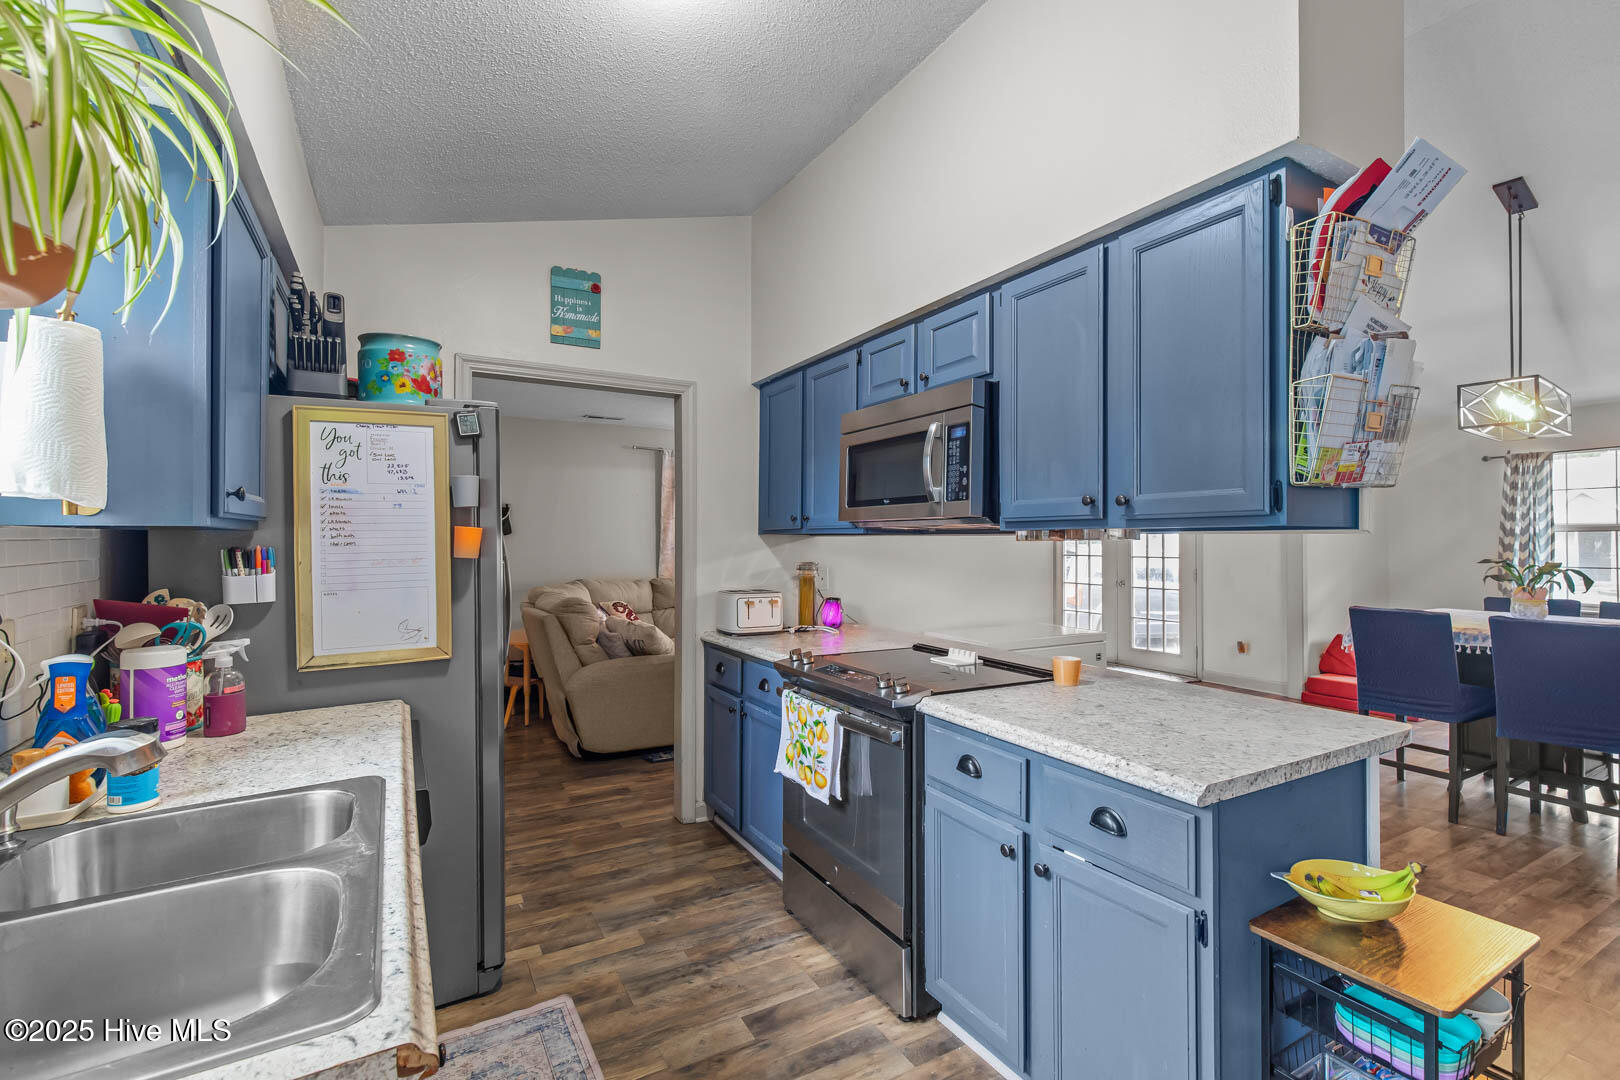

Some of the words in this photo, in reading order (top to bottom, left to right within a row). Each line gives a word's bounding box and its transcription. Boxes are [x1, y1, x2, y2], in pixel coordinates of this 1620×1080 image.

[554, 294, 592, 305] Happiness
[551, 305, 600, 323] Homemade
[320, 426, 353, 450] You
[335, 442, 362, 469] got
[320, 462, 350, 485] this
[166, 674, 187, 683] metho
